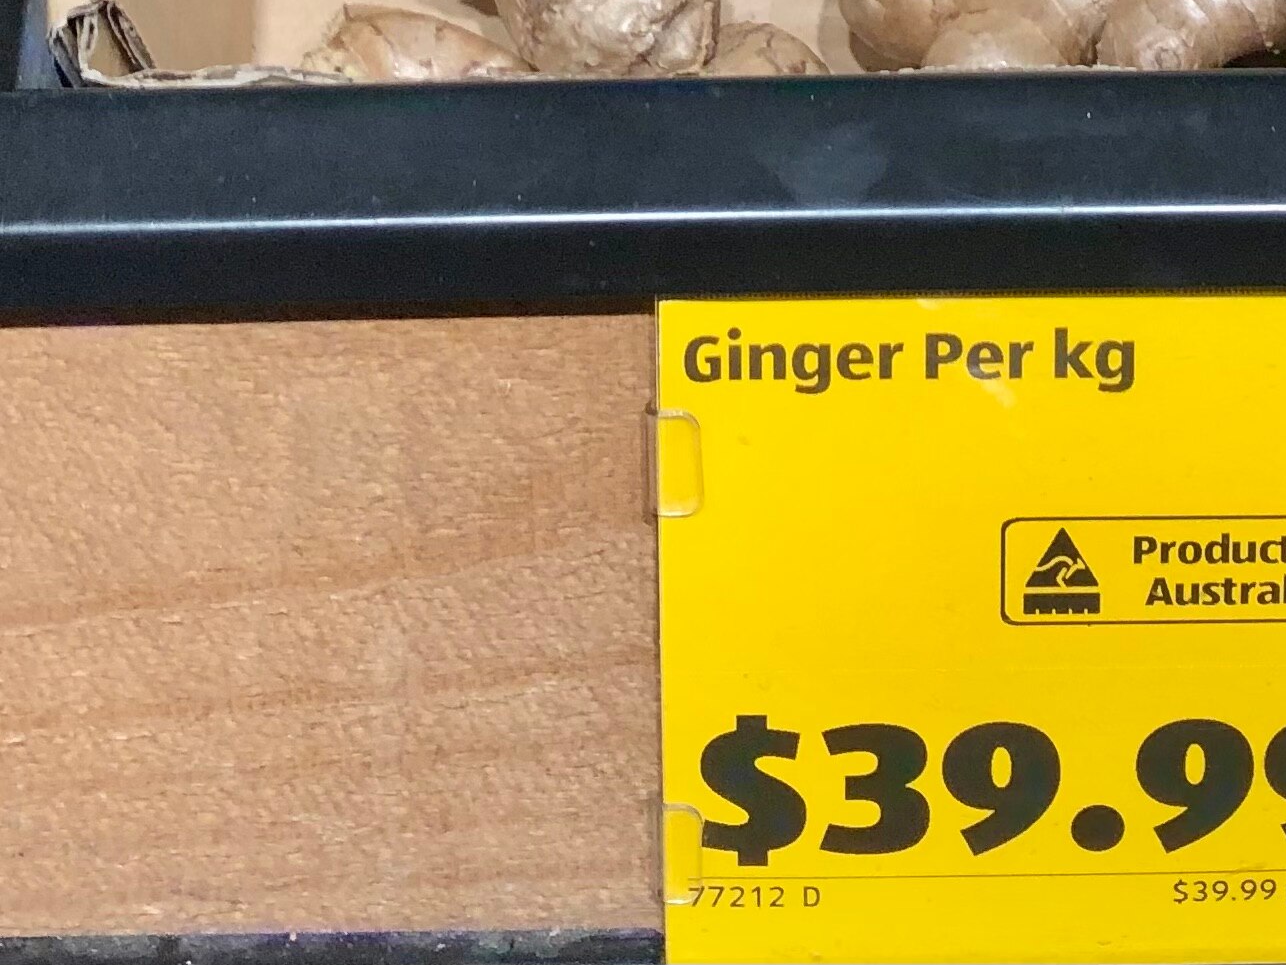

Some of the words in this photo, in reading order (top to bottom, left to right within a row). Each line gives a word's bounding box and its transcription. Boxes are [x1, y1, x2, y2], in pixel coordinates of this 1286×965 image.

[685, 328, 904, 395] Ginger
[925, 333, 1034, 380] Per
[1054, 327, 1136, 393] kg
[688, 886, 785, 908] 77212
[803, 886, 821, 907] D
[1173, 879, 1277, 904] $39.99
